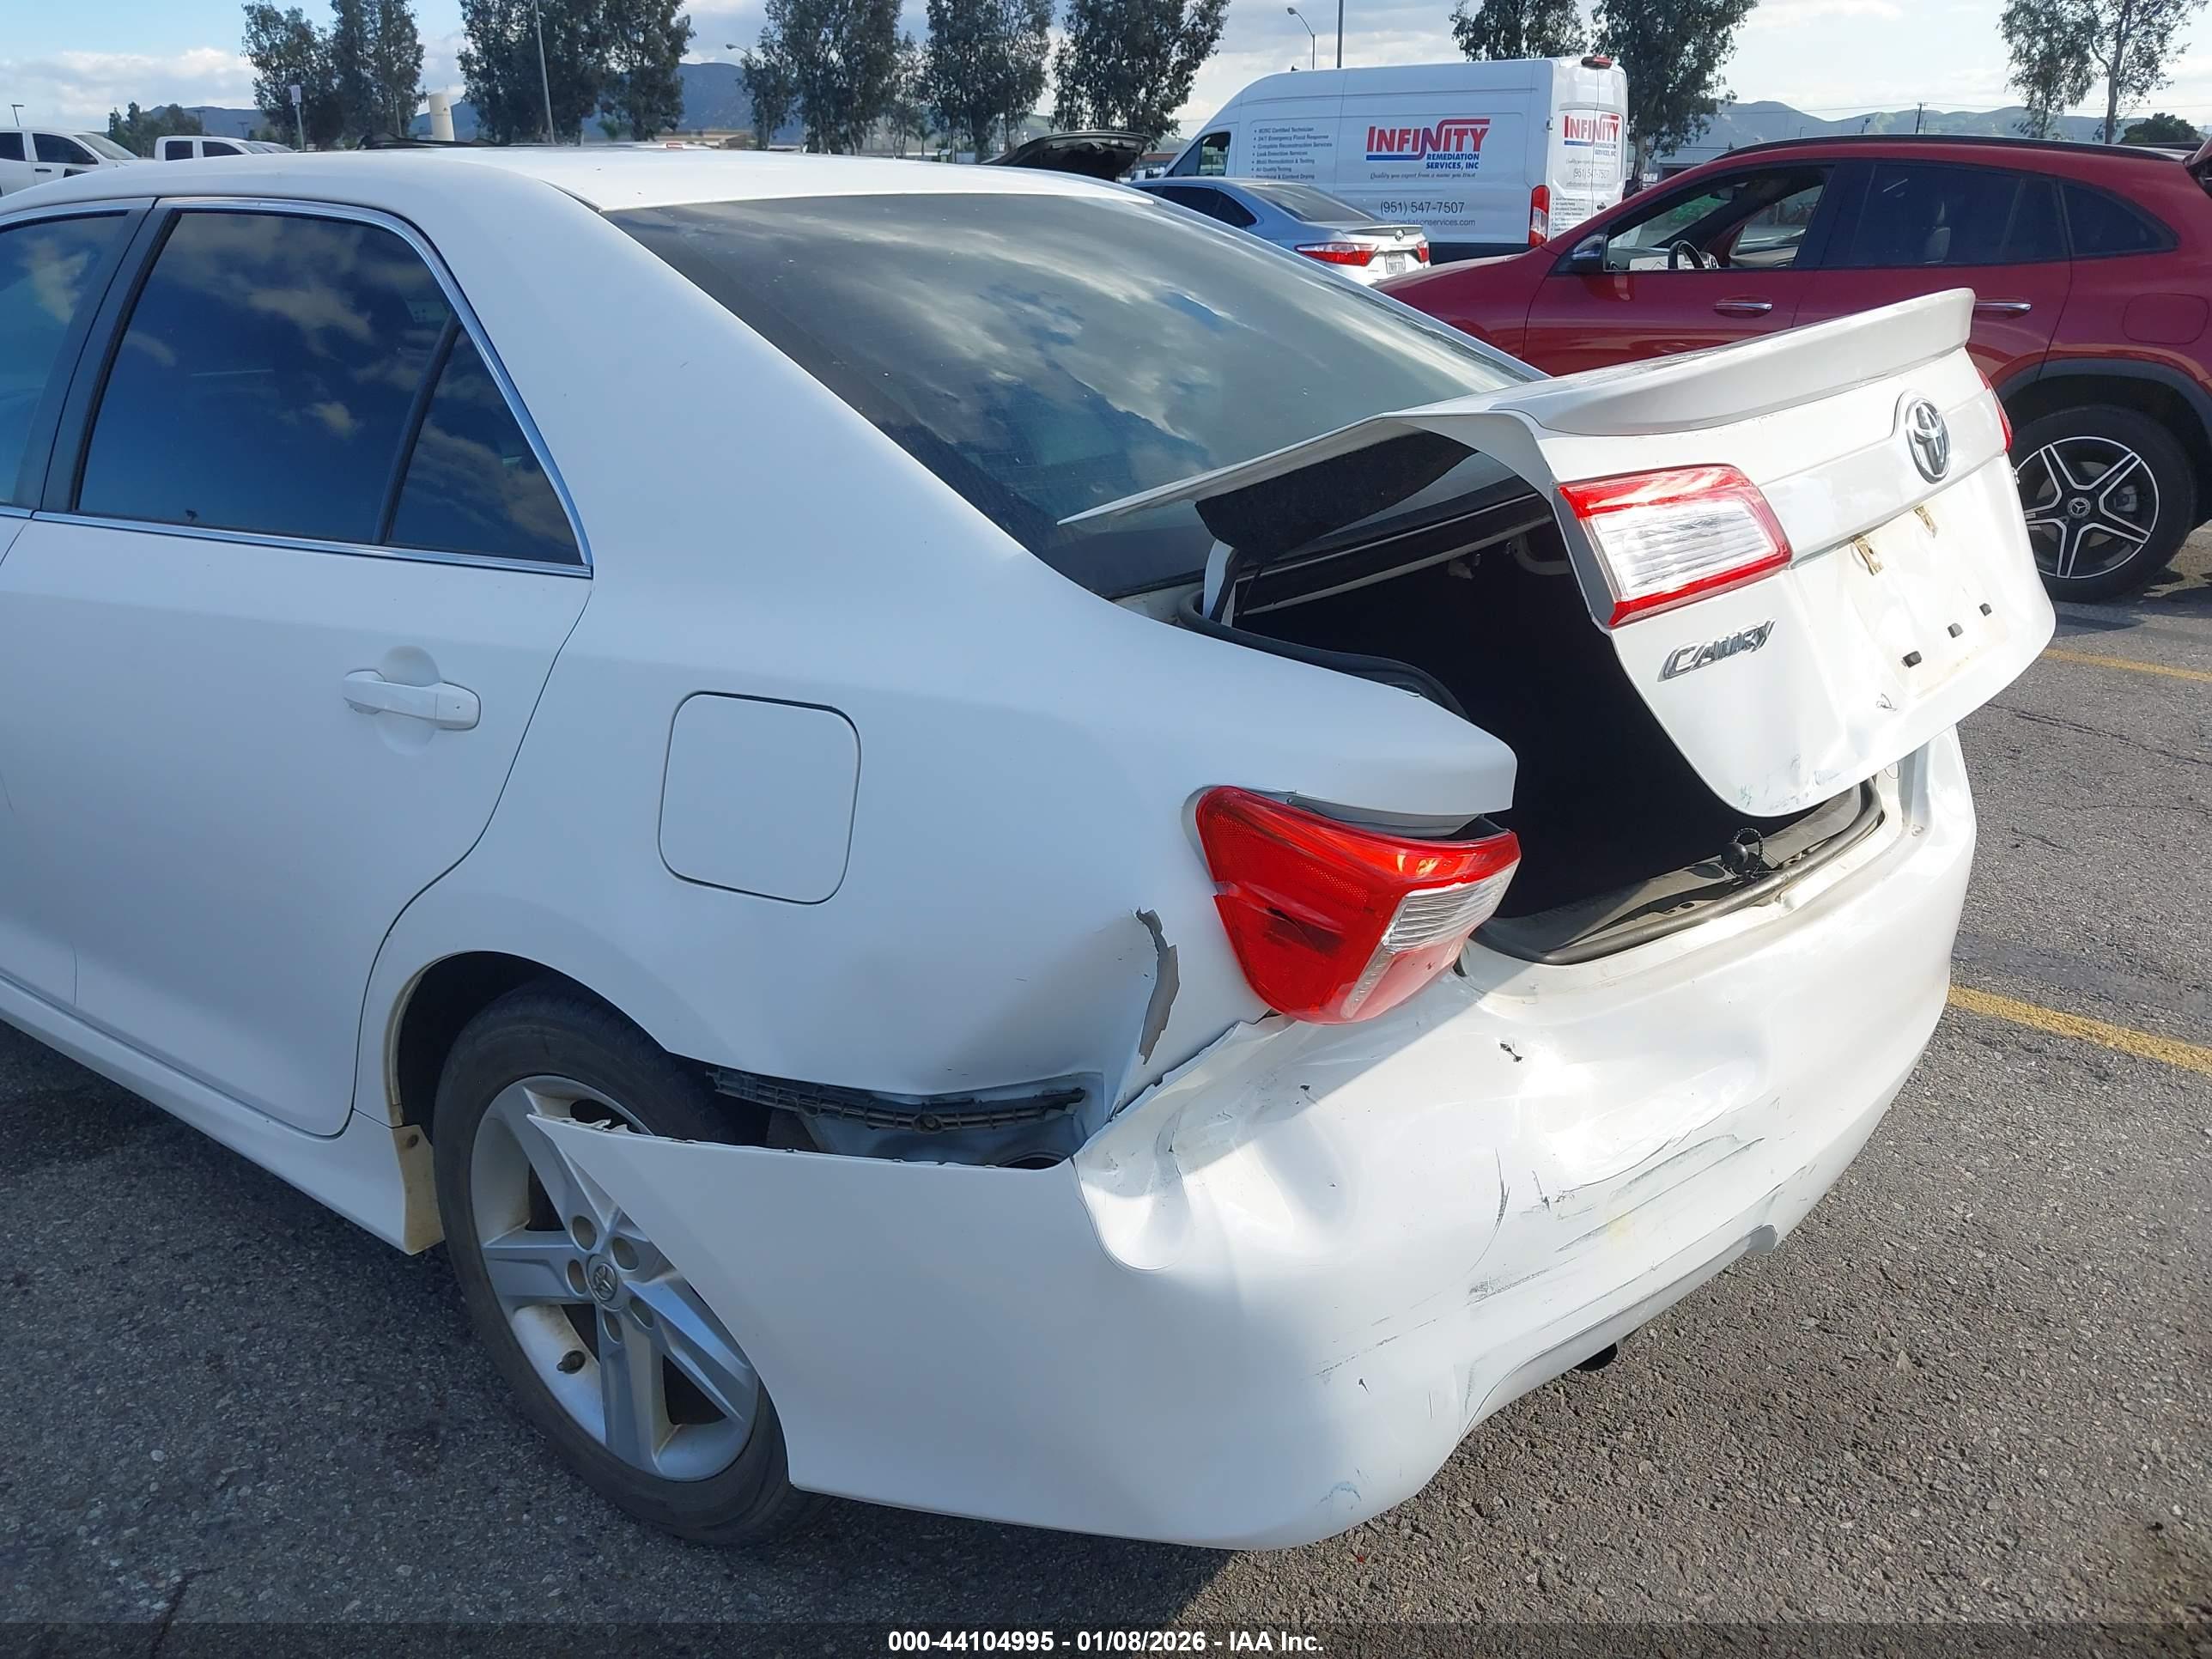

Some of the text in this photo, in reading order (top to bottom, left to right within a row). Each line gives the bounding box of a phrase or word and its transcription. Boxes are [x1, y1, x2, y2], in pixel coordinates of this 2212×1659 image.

[1365, 119, 1491, 153] INFINITY
[1564, 114, 1620, 143] INFINITY
[1425, 161, 1463, 171] SERVICES,
[1380, 201, 1465, 216] (951) 547-7507
[1658, 618, 1776, 682] CAMRY
